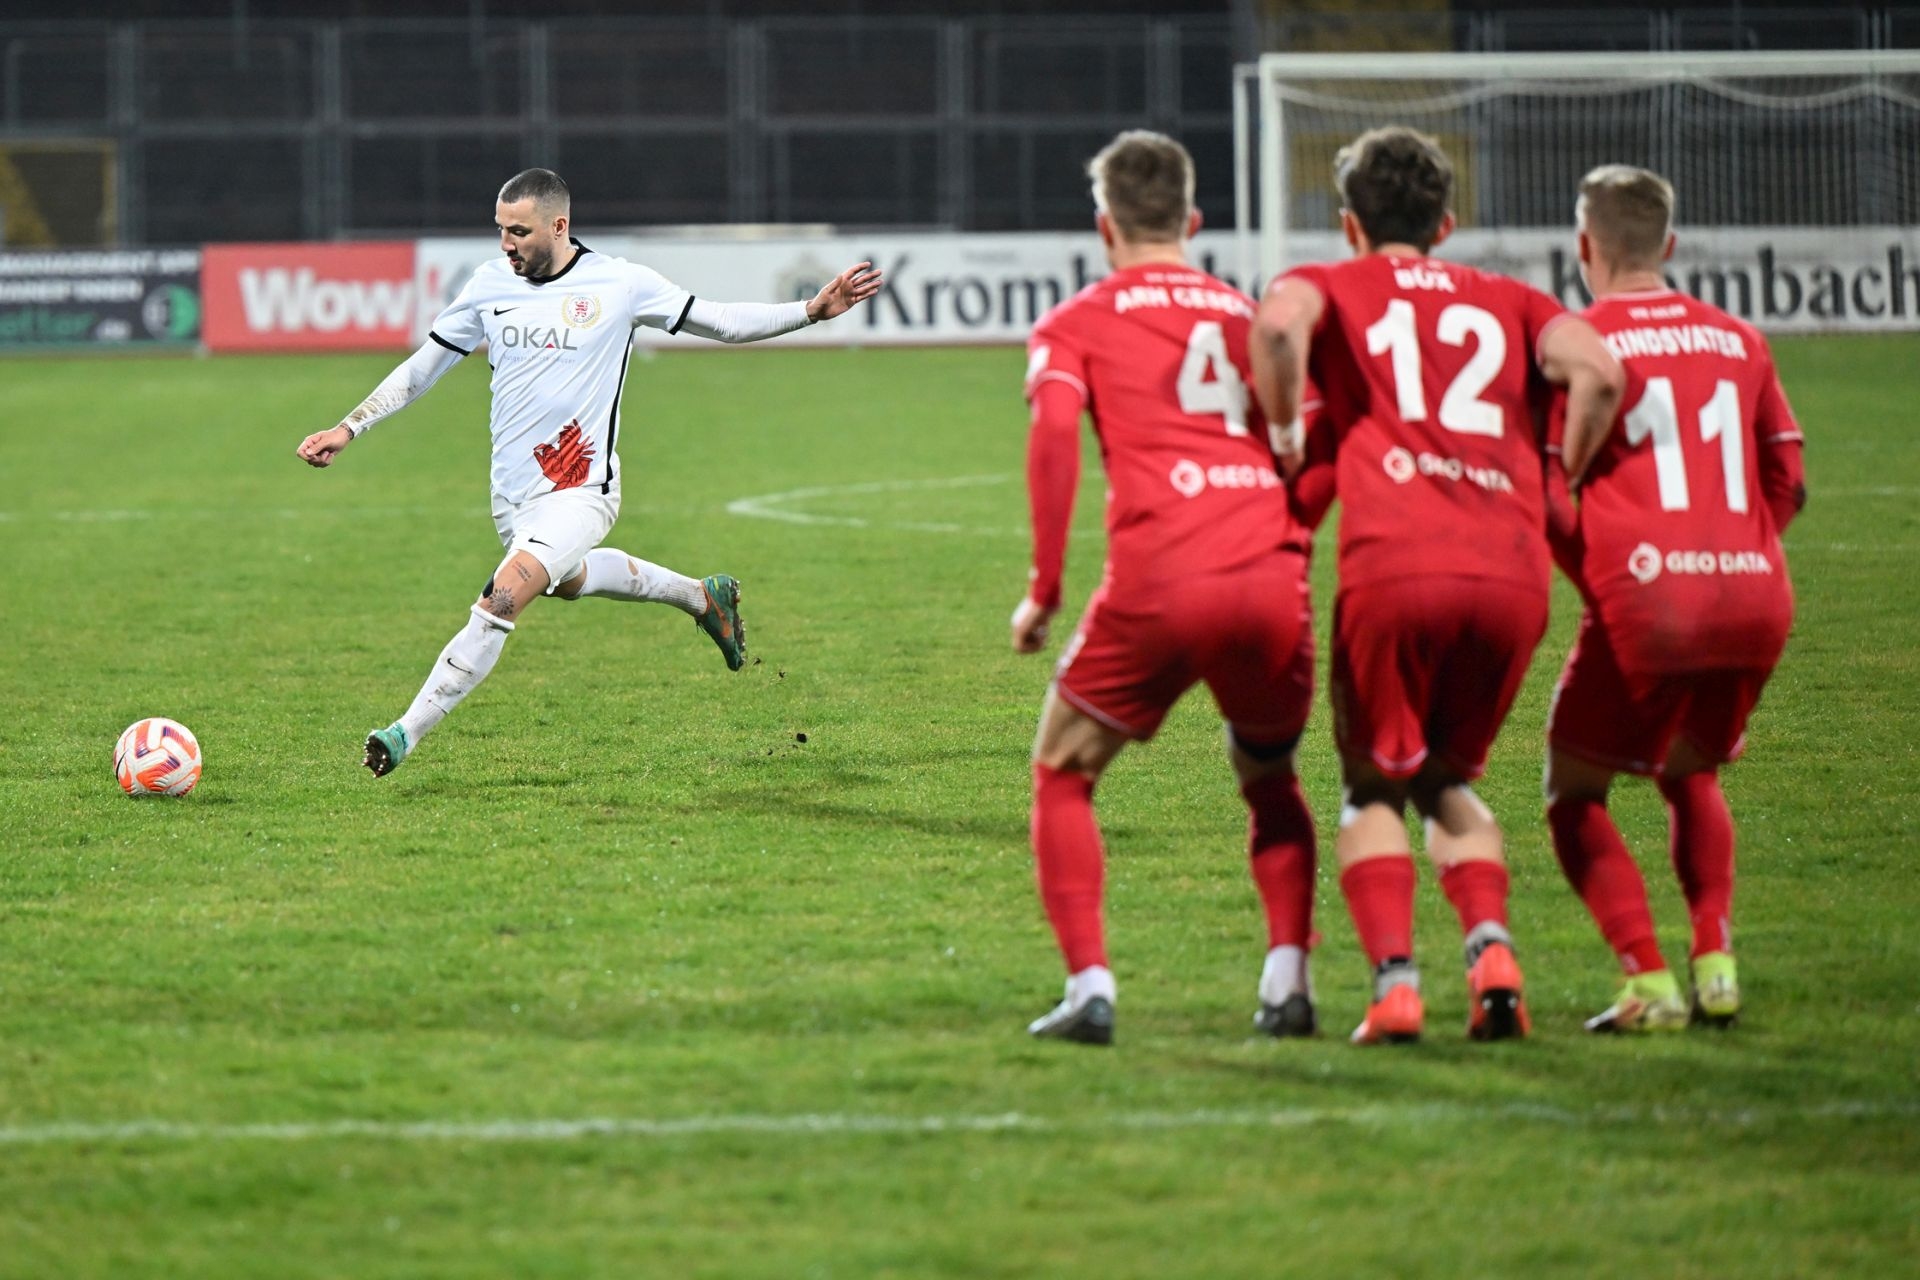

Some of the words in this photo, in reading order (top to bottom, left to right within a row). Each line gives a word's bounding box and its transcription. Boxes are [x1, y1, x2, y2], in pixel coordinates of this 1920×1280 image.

[502, 325, 578, 351] OKAL
[1604, 324, 1748, 361] KINDSVATER
[1176, 319, 1250, 437] 4
[1365, 298, 1507, 440] 12
[1624, 375, 1749, 513] 11
[1206, 464, 1257, 489] GEO
[1665, 551, 1718, 574] GEO
[1719, 552, 1772, 574] DATA
